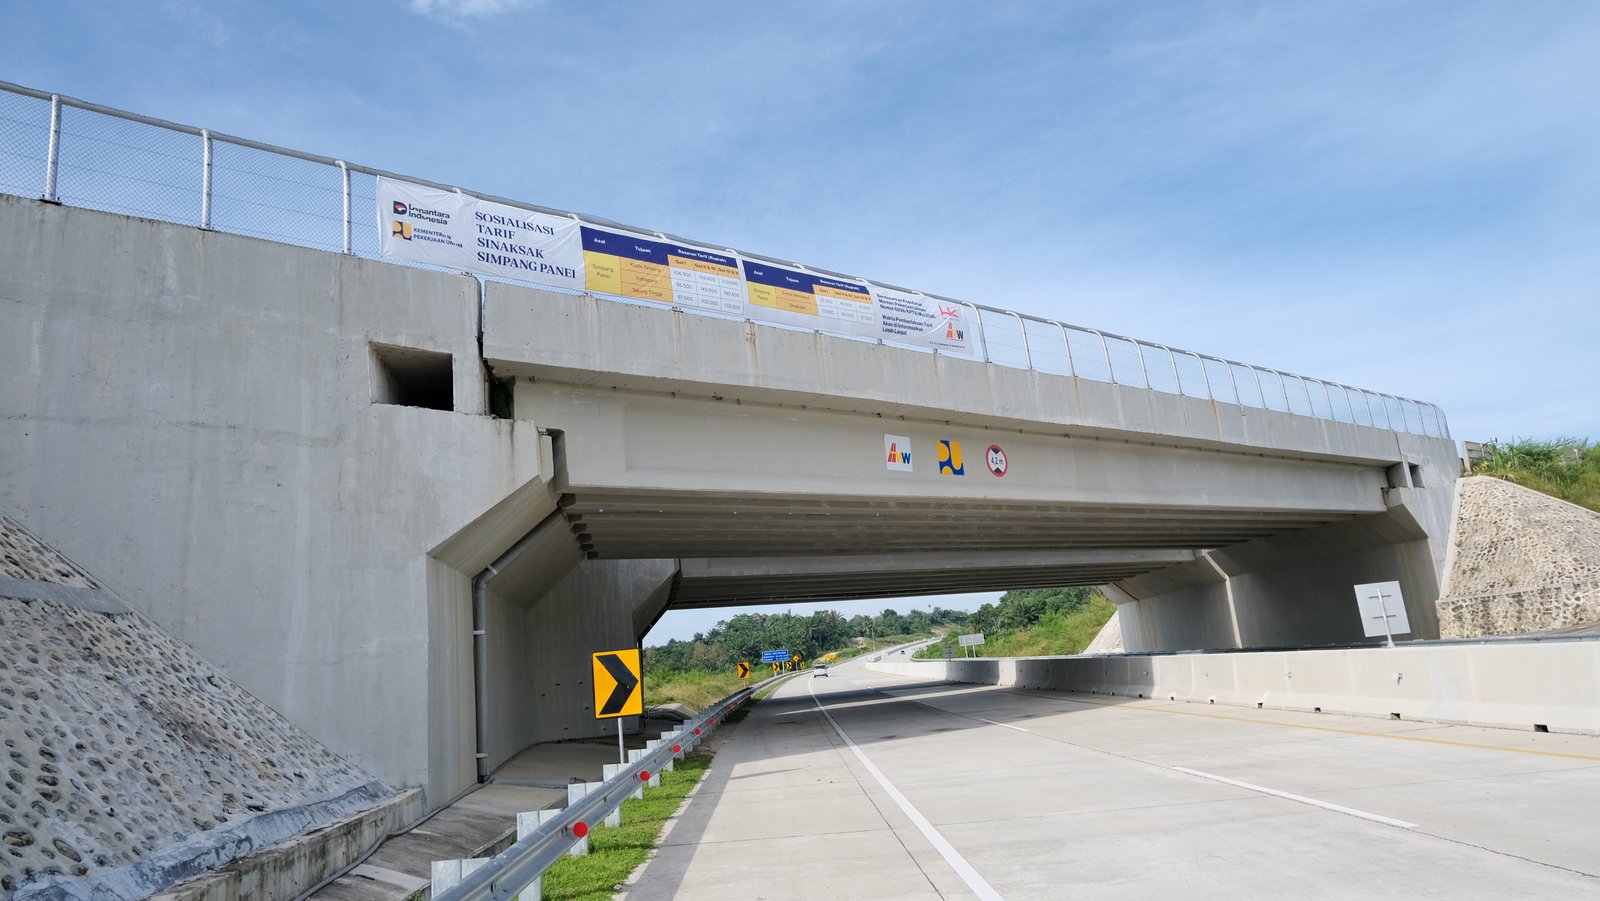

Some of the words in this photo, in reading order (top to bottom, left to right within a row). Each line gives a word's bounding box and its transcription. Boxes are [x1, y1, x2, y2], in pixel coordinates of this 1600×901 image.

[475, 211, 554, 236] SOSIALISASI
[413, 228, 451, 240] KEMENTERN
[476, 223, 515, 240] TARIF
[413, 234, 445, 244] PEKERJAAN
[477, 237, 544, 259] SINAKSAK
[634, 246, 652, 254] Tujuan
[477, 251, 537, 271] SIMPANG
[540, 263, 576, 279] PANEI
[592, 264, 614, 272] Simpang
